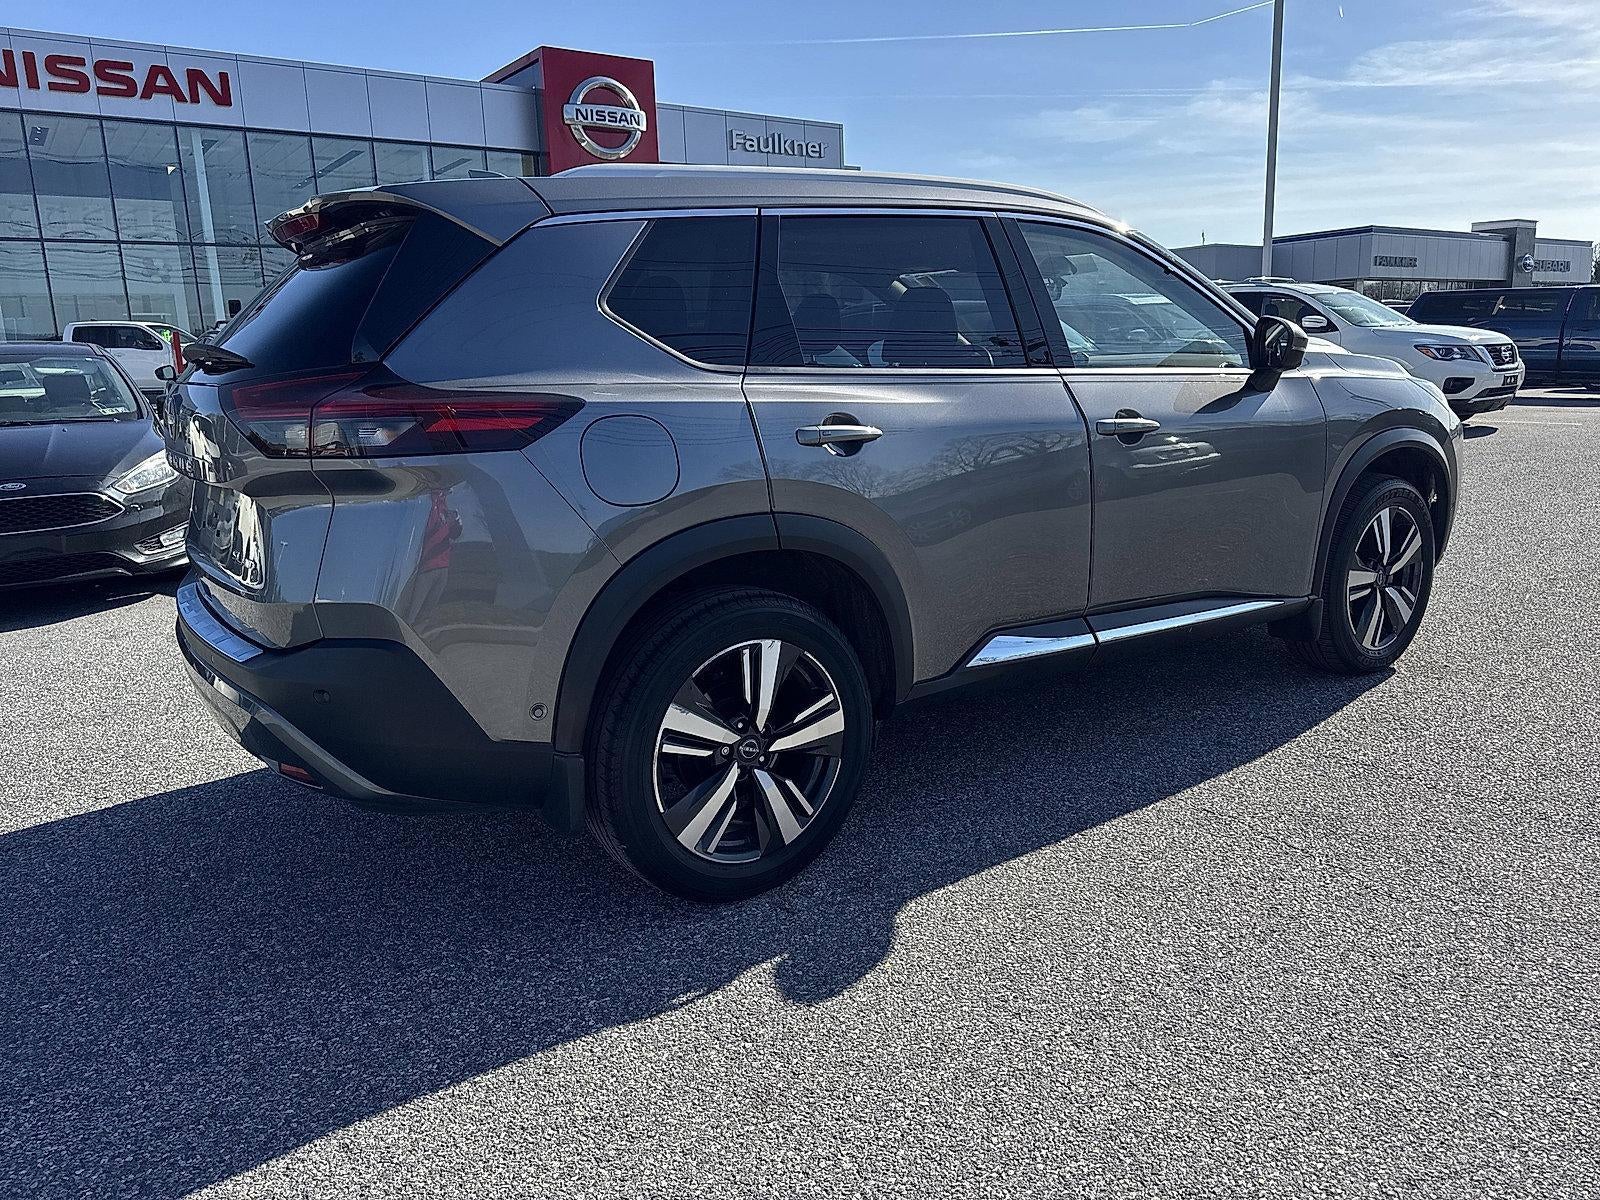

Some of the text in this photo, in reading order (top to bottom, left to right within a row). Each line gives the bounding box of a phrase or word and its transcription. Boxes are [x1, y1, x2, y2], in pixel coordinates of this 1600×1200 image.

[575, 108, 641, 127] NISSAN
[729, 129, 829, 158] Faulkner
[1533, 260, 1571, 272] SUBARU
